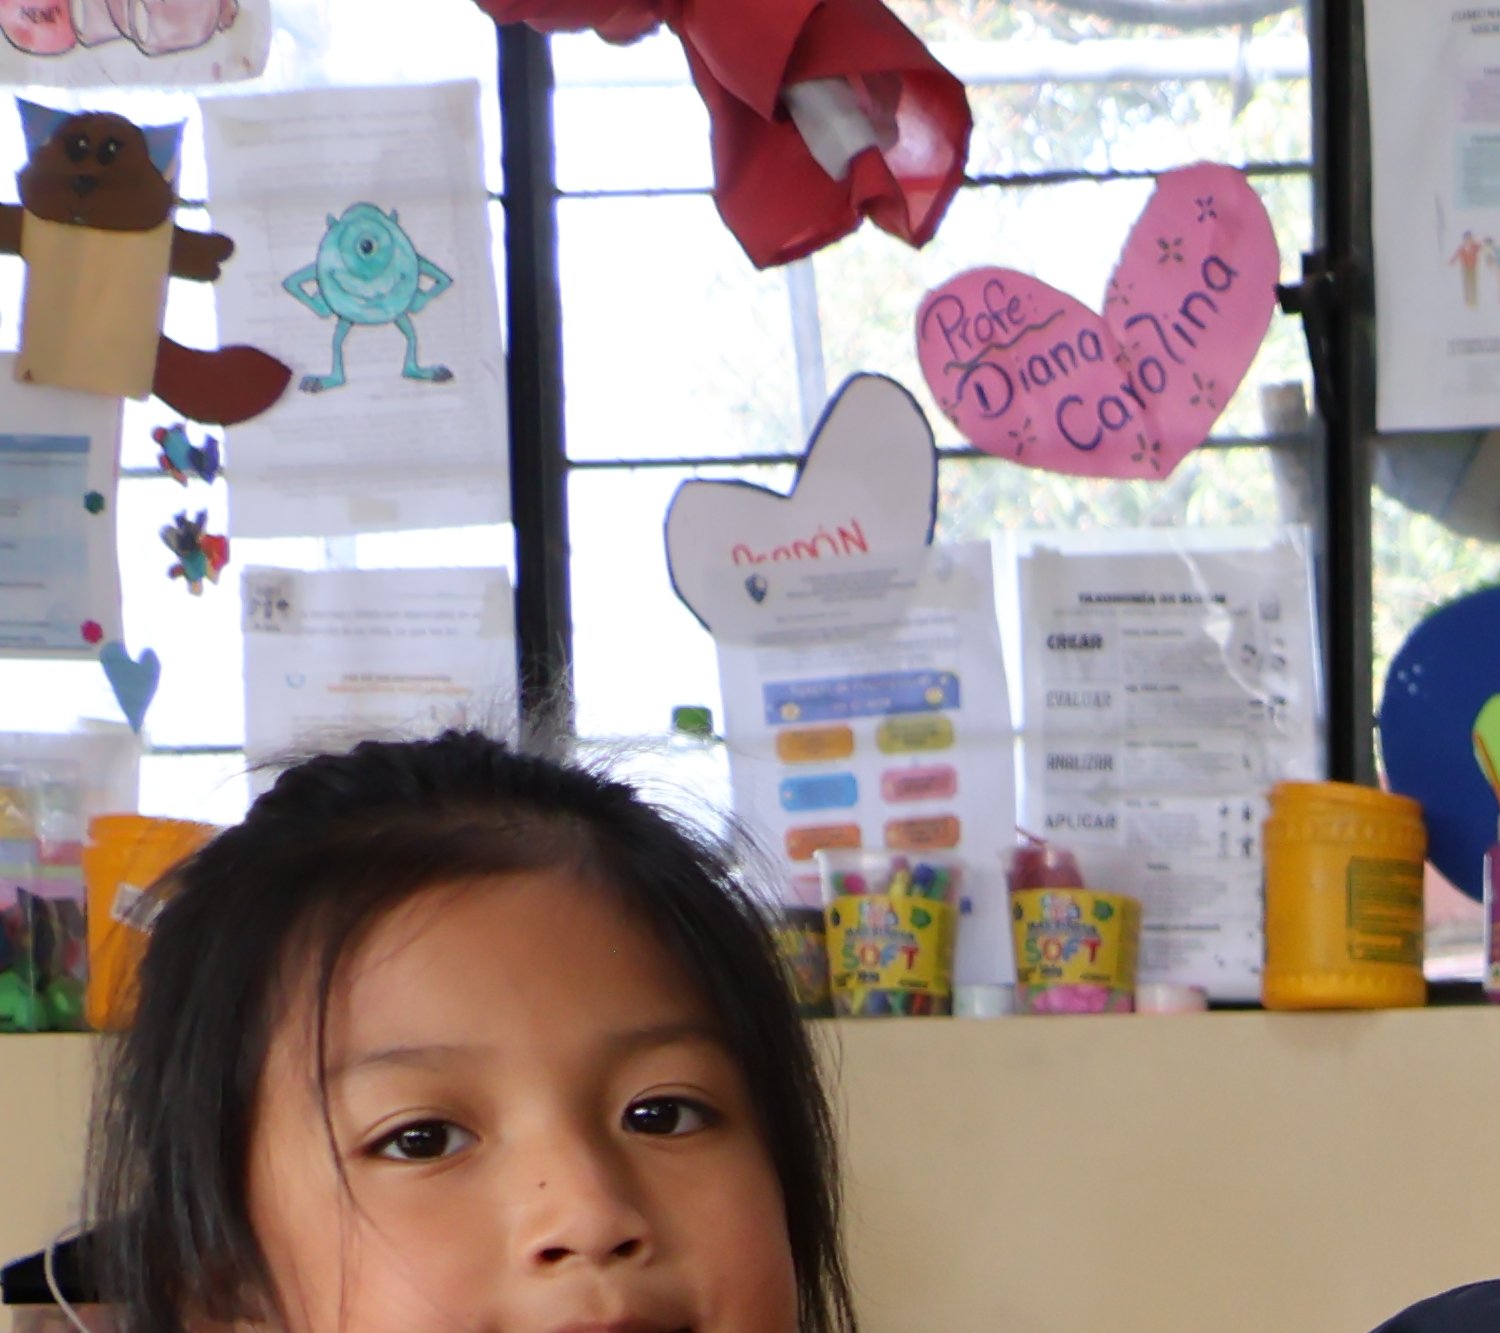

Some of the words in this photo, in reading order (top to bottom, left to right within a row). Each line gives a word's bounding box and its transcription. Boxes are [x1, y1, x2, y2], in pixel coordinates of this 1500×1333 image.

[1056, 254, 1238, 451] Carolina
[957, 328, 1104, 419] Diana
[1047, 633, 1103, 650] CREAR
[1046, 691, 1111, 707] EVALUAR
[1046, 753, 1113, 771] ANALIZAR
[1044, 813, 1117, 830] APLICAR
[842, 943, 919, 970] SOFT
[1025, 937, 1102, 965] SOFT
